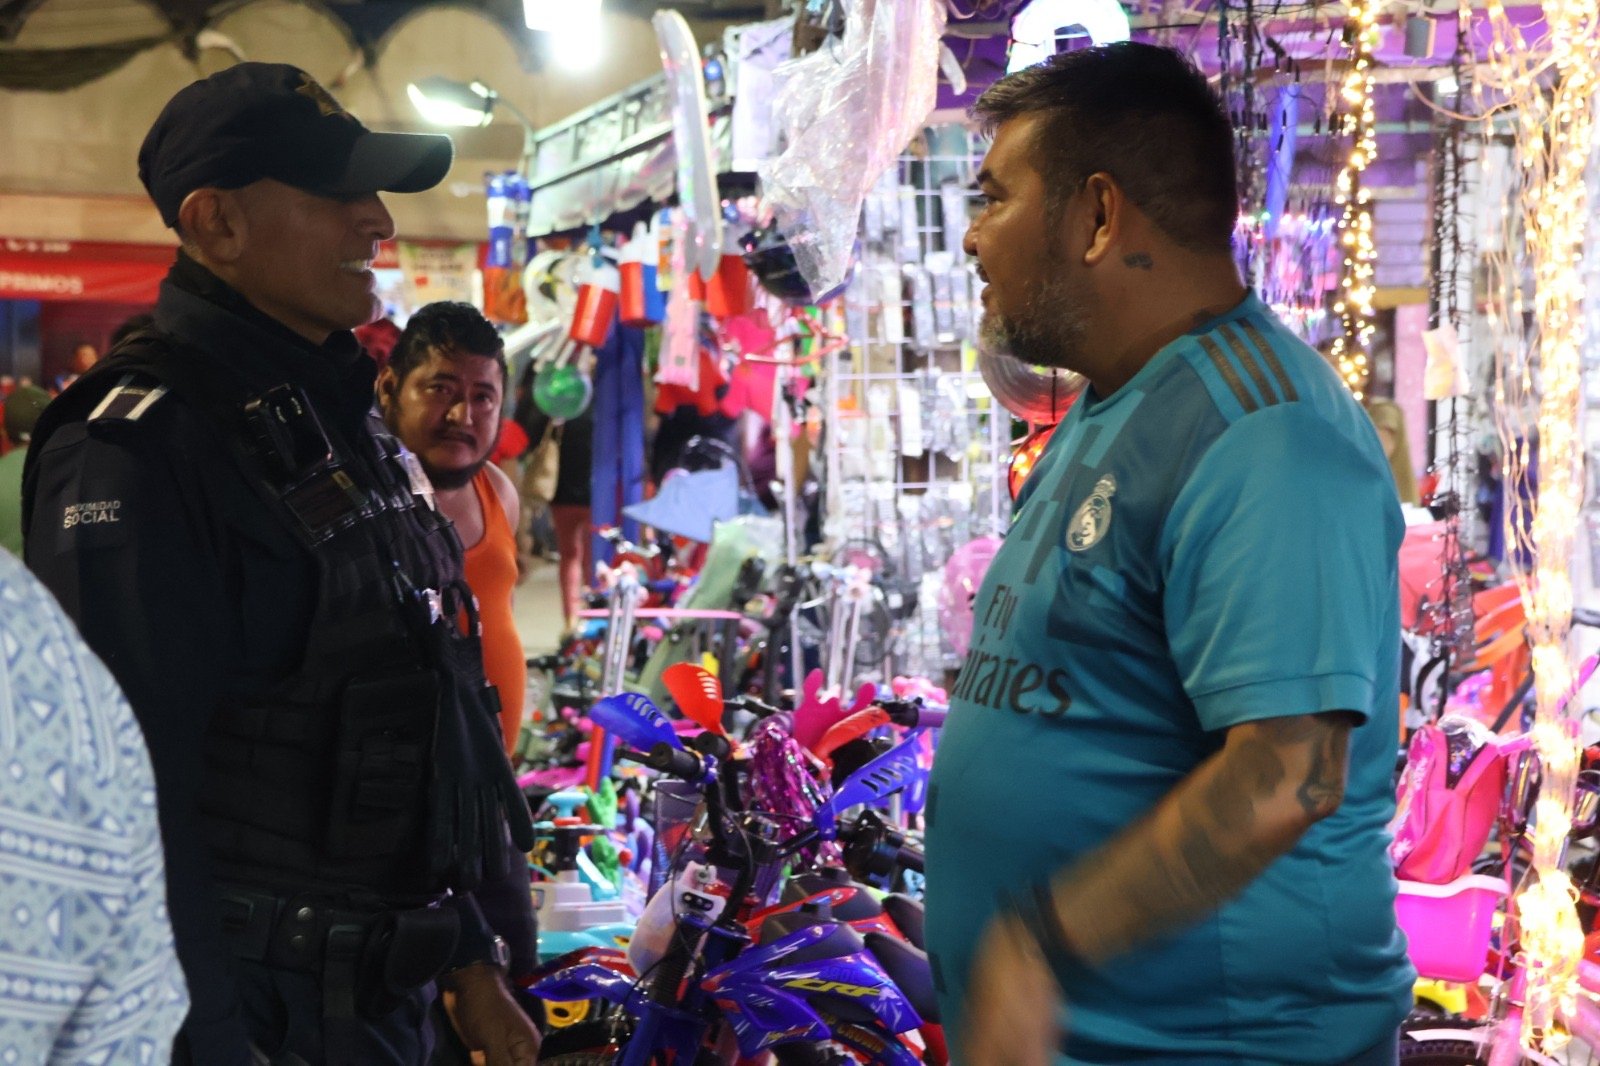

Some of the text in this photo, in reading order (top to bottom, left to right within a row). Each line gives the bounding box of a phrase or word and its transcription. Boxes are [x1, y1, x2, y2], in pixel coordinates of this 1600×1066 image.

[63, 510, 120, 529] SOCIAL
[983, 584, 1019, 641] Fly
[784, 977, 881, 998] CRF
